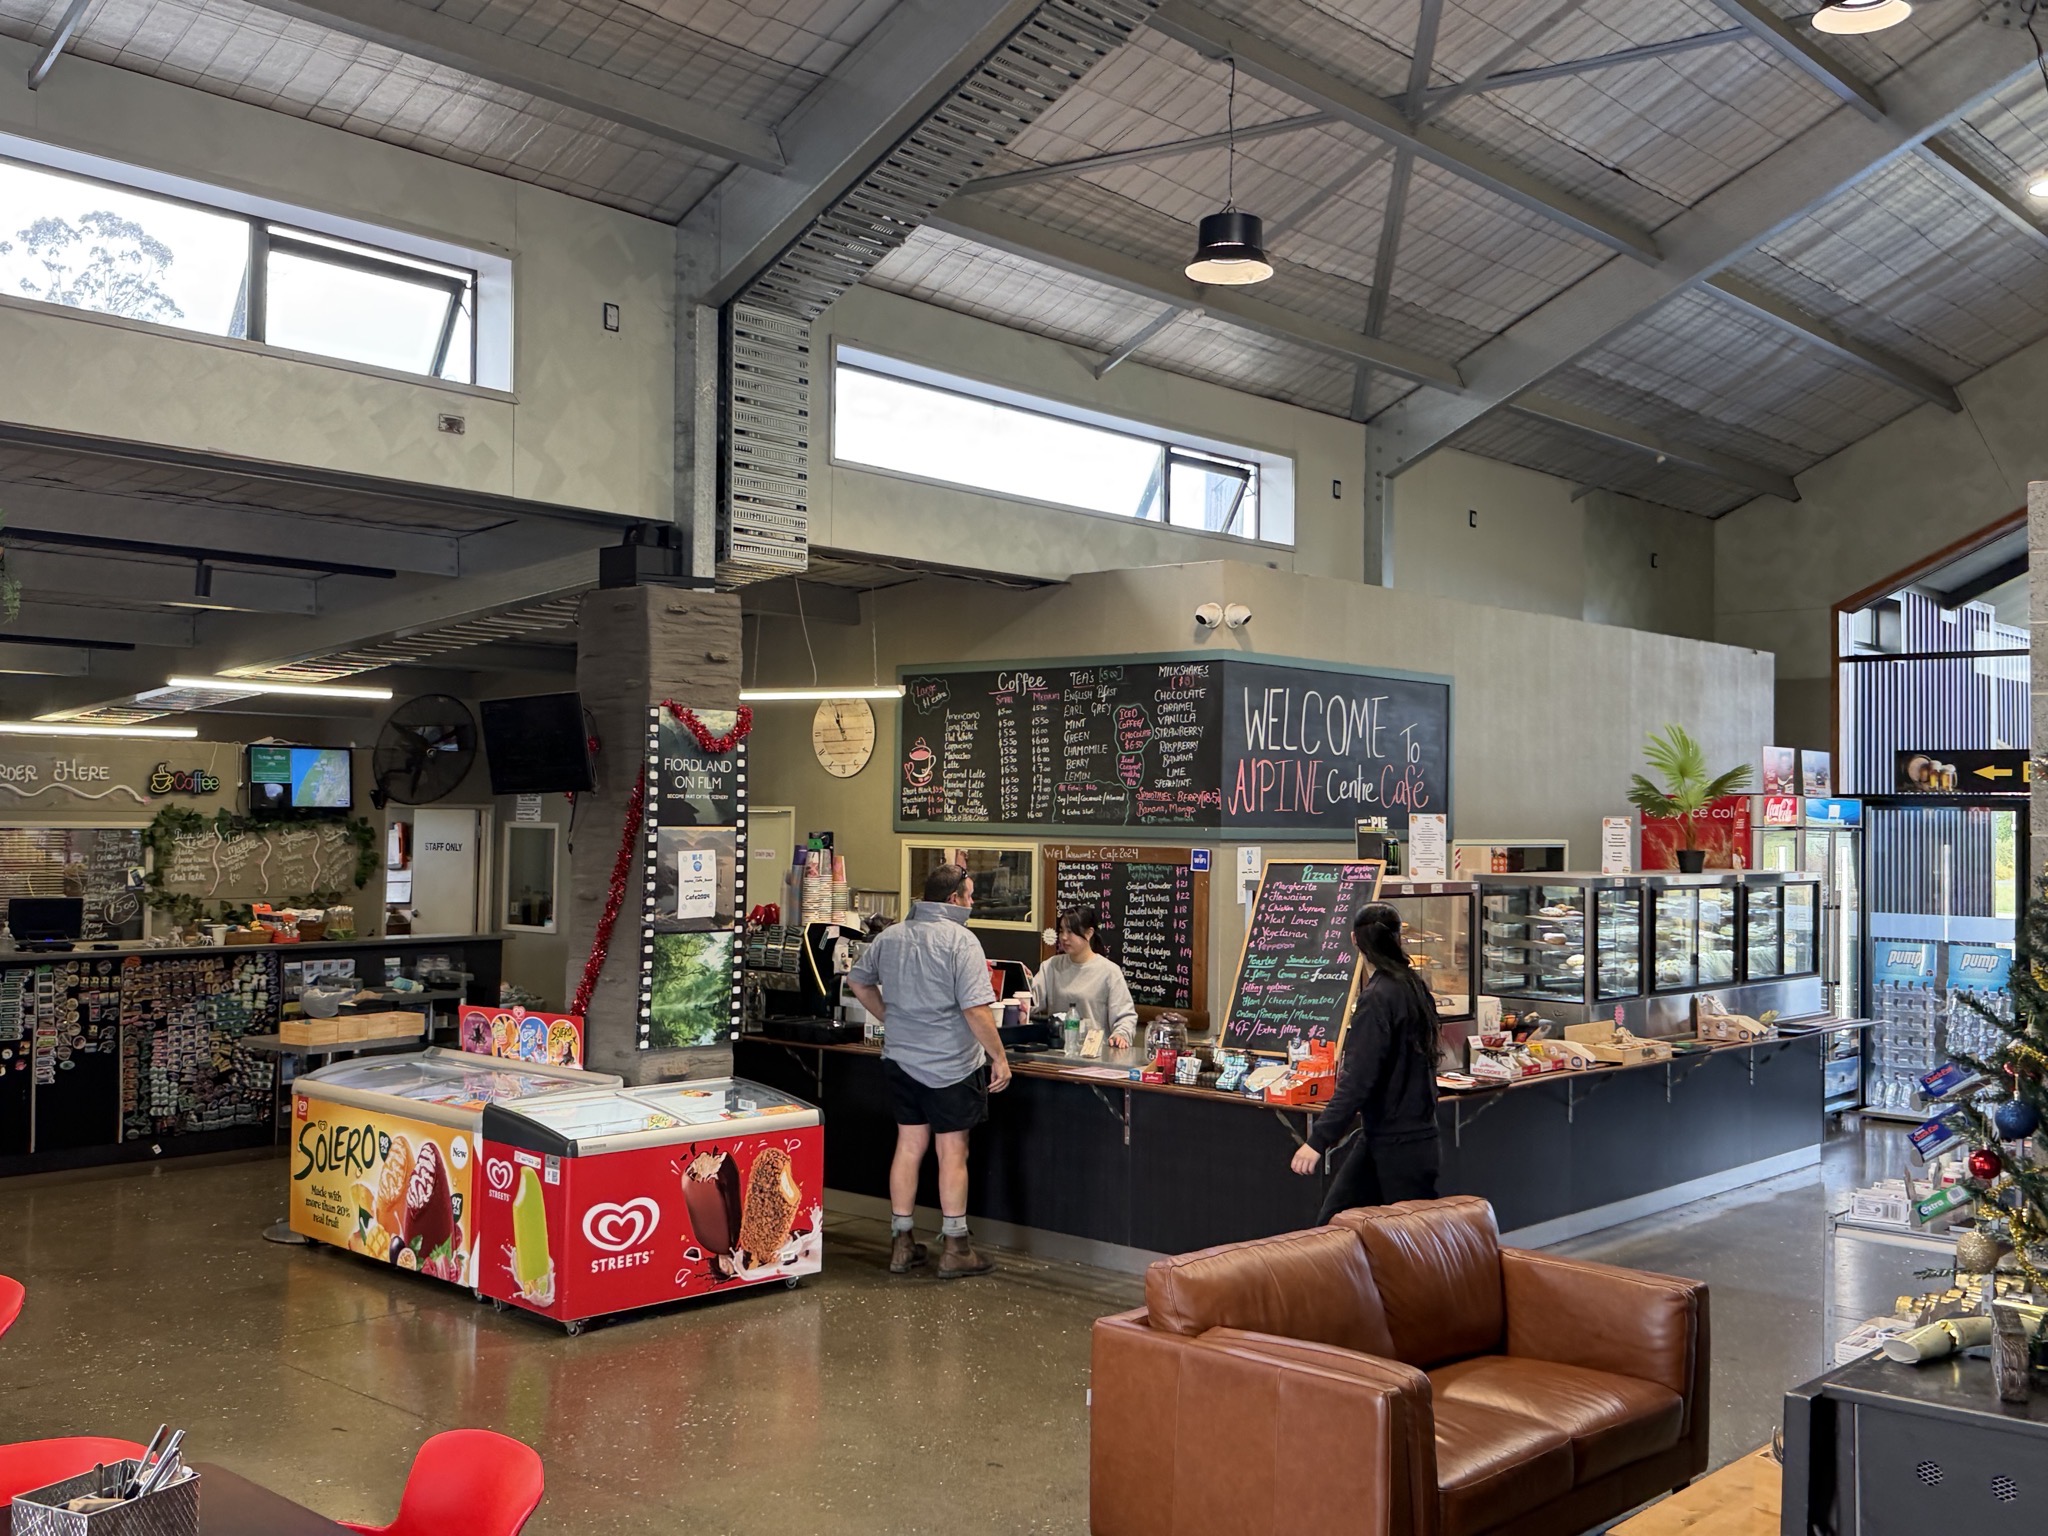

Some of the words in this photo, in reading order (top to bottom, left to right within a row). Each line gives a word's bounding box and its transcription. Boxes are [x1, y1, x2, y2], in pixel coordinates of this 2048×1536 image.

[998, 672, 1046, 696] Coffee
[1154, 688, 1206, 702] CHOCOLATE
[1157, 701, 1197, 715] CARAMEL
[1065, 718, 1087, 730] MINT
[1157, 712, 1196, 725] VANILLA
[1244, 686, 1389, 759] WELCOME
[1063, 730, 1090, 745] GREEN
[1154, 725, 1204, 740] STRAWBERRY
[1400, 723, 1420, 763] To
[1063, 744, 1108, 757] CHAMOMILE
[664, 757, 732, 773] FIORDLAND
[1066, 758, 1089, 770] BERRY
[0, 764, 38, 783] RDER
[1065, 771, 1090, 781] LEMON
[1166, 767, 1187, 778] LIME
[174, 771, 219, 793] Coffee
[674, 775, 694, 789] ON
[698, 776, 721, 789] FILM
[1326, 764, 1379, 804] Centre
[1380, 763, 1429, 813] Café
[1371, 816, 1387, 829] PIE
[425, 842, 444, 851] STAFF
[445, 843, 463, 851] ONLY
[1301, 864, 1339, 883] Pizza's
[1272, 881, 1318, 894] Margherita
[1268, 889, 1313, 901] Hawaiian
[1264, 913, 1285, 924] Meat
[1290, 914, 1319, 927] Lovers
[1262, 926, 1309, 941] Vegetarian
[1886, 950, 1922, 969] pump
[1960, 953, 1999, 972] pump
[1308, 1024, 1326, 1038] $2
[293, 1120, 375, 1180] SOLERO
[452, 1147, 467, 1158] New
[311, 1184, 327, 1198] Made
[328, 1190, 342, 1203] with
[488, 1188, 512, 1202] STREETS
[305, 1198, 321, 1209] more
[322, 1200, 336, 1213] than
[336, 1205, 351, 1218] 20%
[452, 1197, 462, 1208] 97
[1920, 1199, 1945, 1216] extra
[313, 1214, 325, 1225] real
[591, 1250, 655, 1274] STREETS
